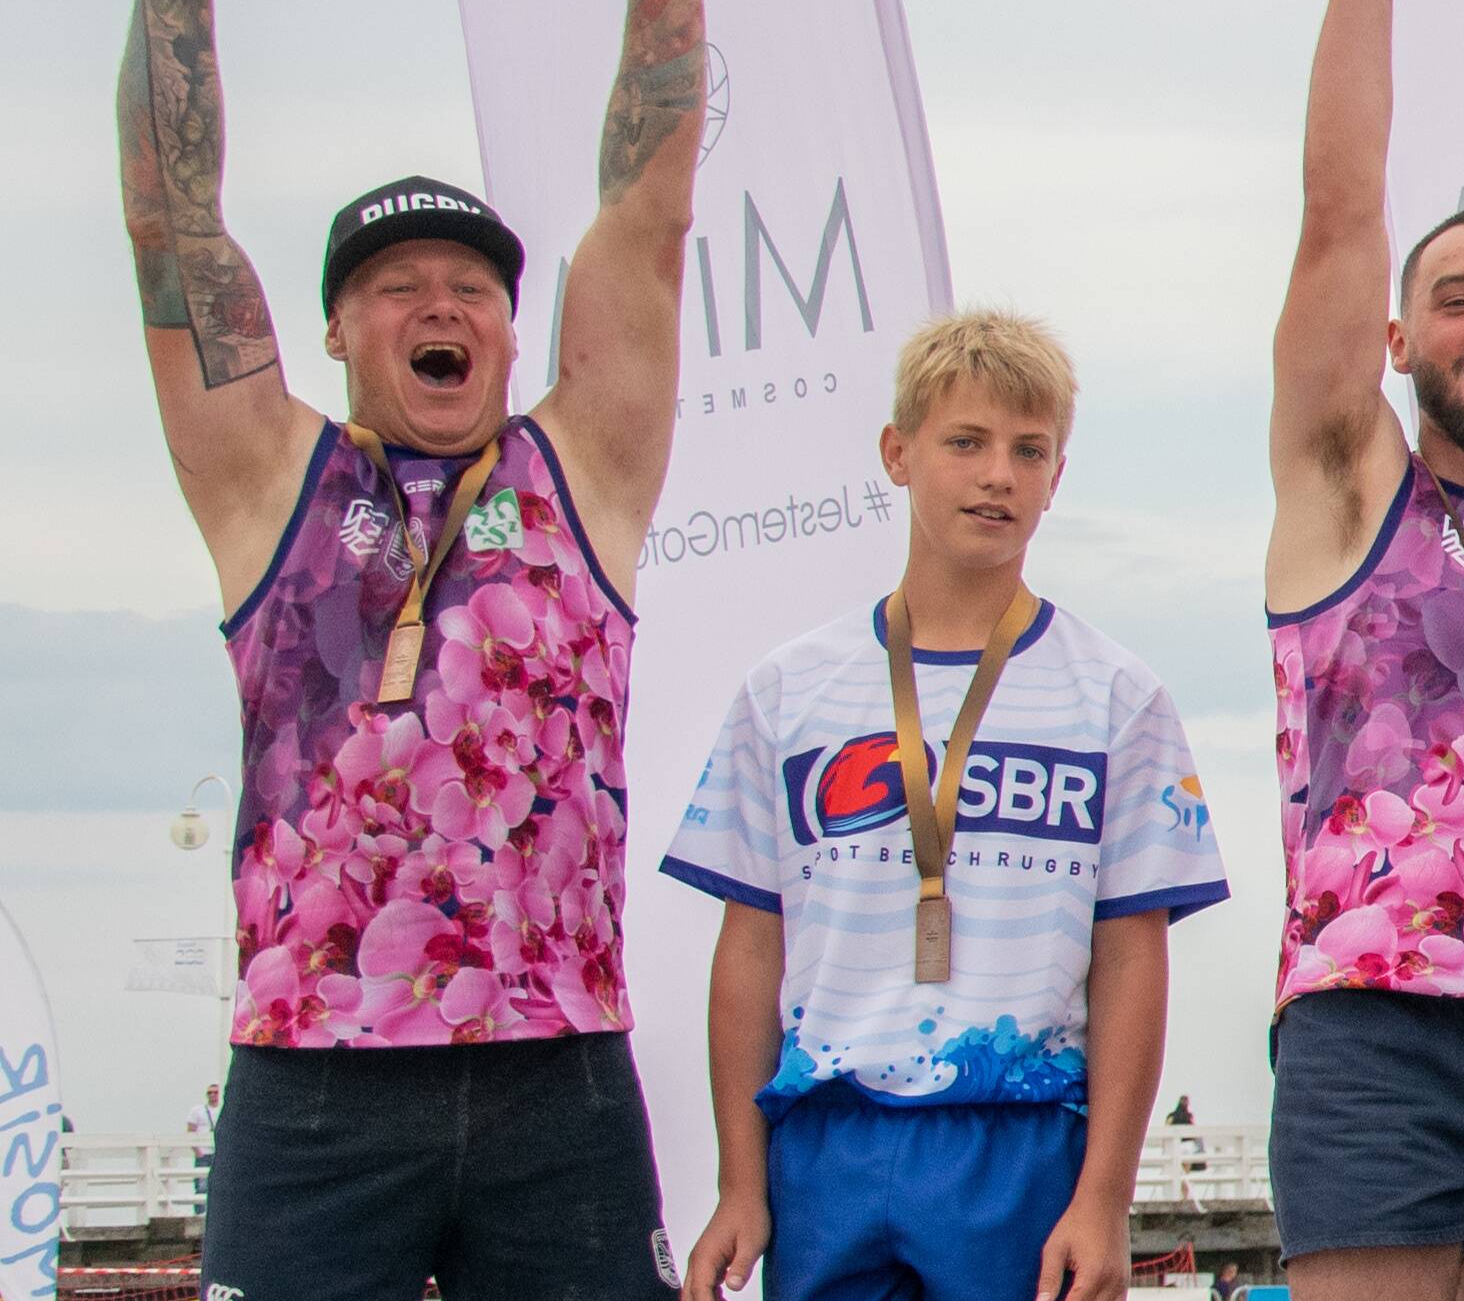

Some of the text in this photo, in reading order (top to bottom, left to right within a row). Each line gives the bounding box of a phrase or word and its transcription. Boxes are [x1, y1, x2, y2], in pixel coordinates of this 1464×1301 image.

[958, 753, 1098, 831] SBR
[880, 848, 981, 867] BECH
[999, 850, 1100, 880] RUGBY
